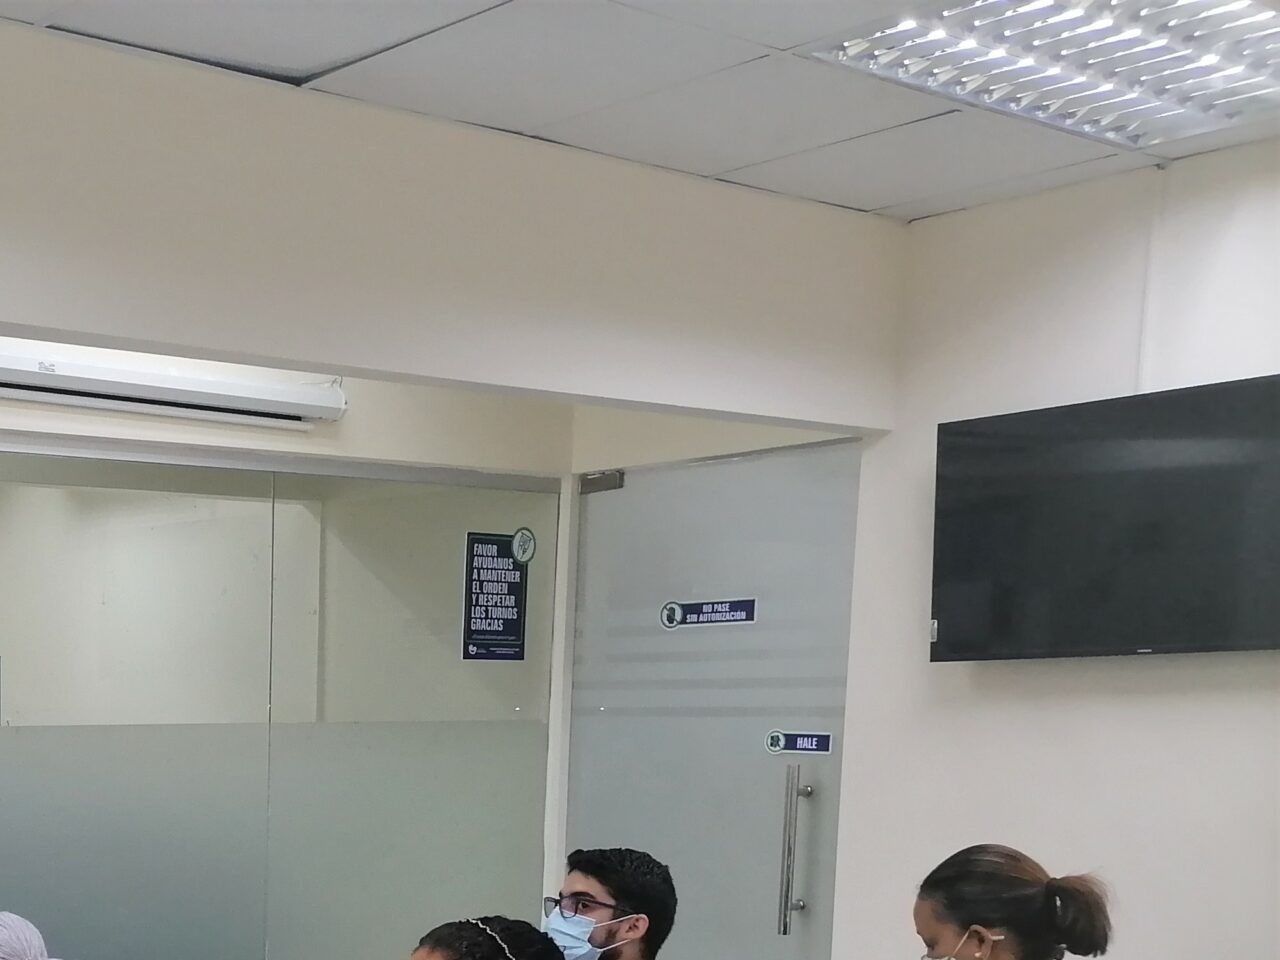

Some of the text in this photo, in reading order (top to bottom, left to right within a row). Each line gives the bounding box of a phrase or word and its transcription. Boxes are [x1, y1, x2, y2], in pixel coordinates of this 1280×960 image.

[473, 543, 498, 556] FAVOR
[472, 569, 521, 583] A MANTENER
[472, 581, 508, 594] EL ORDEN
[472, 594, 515, 607] Y RESPETAR
[471, 606, 518, 619] LOS TURNOS
[702, 602, 731, 613] NO PASE
[470, 618, 504, 631] GRACIAS
[686, 614, 698, 622] SIN
[796, 737, 818, 749] HALE
